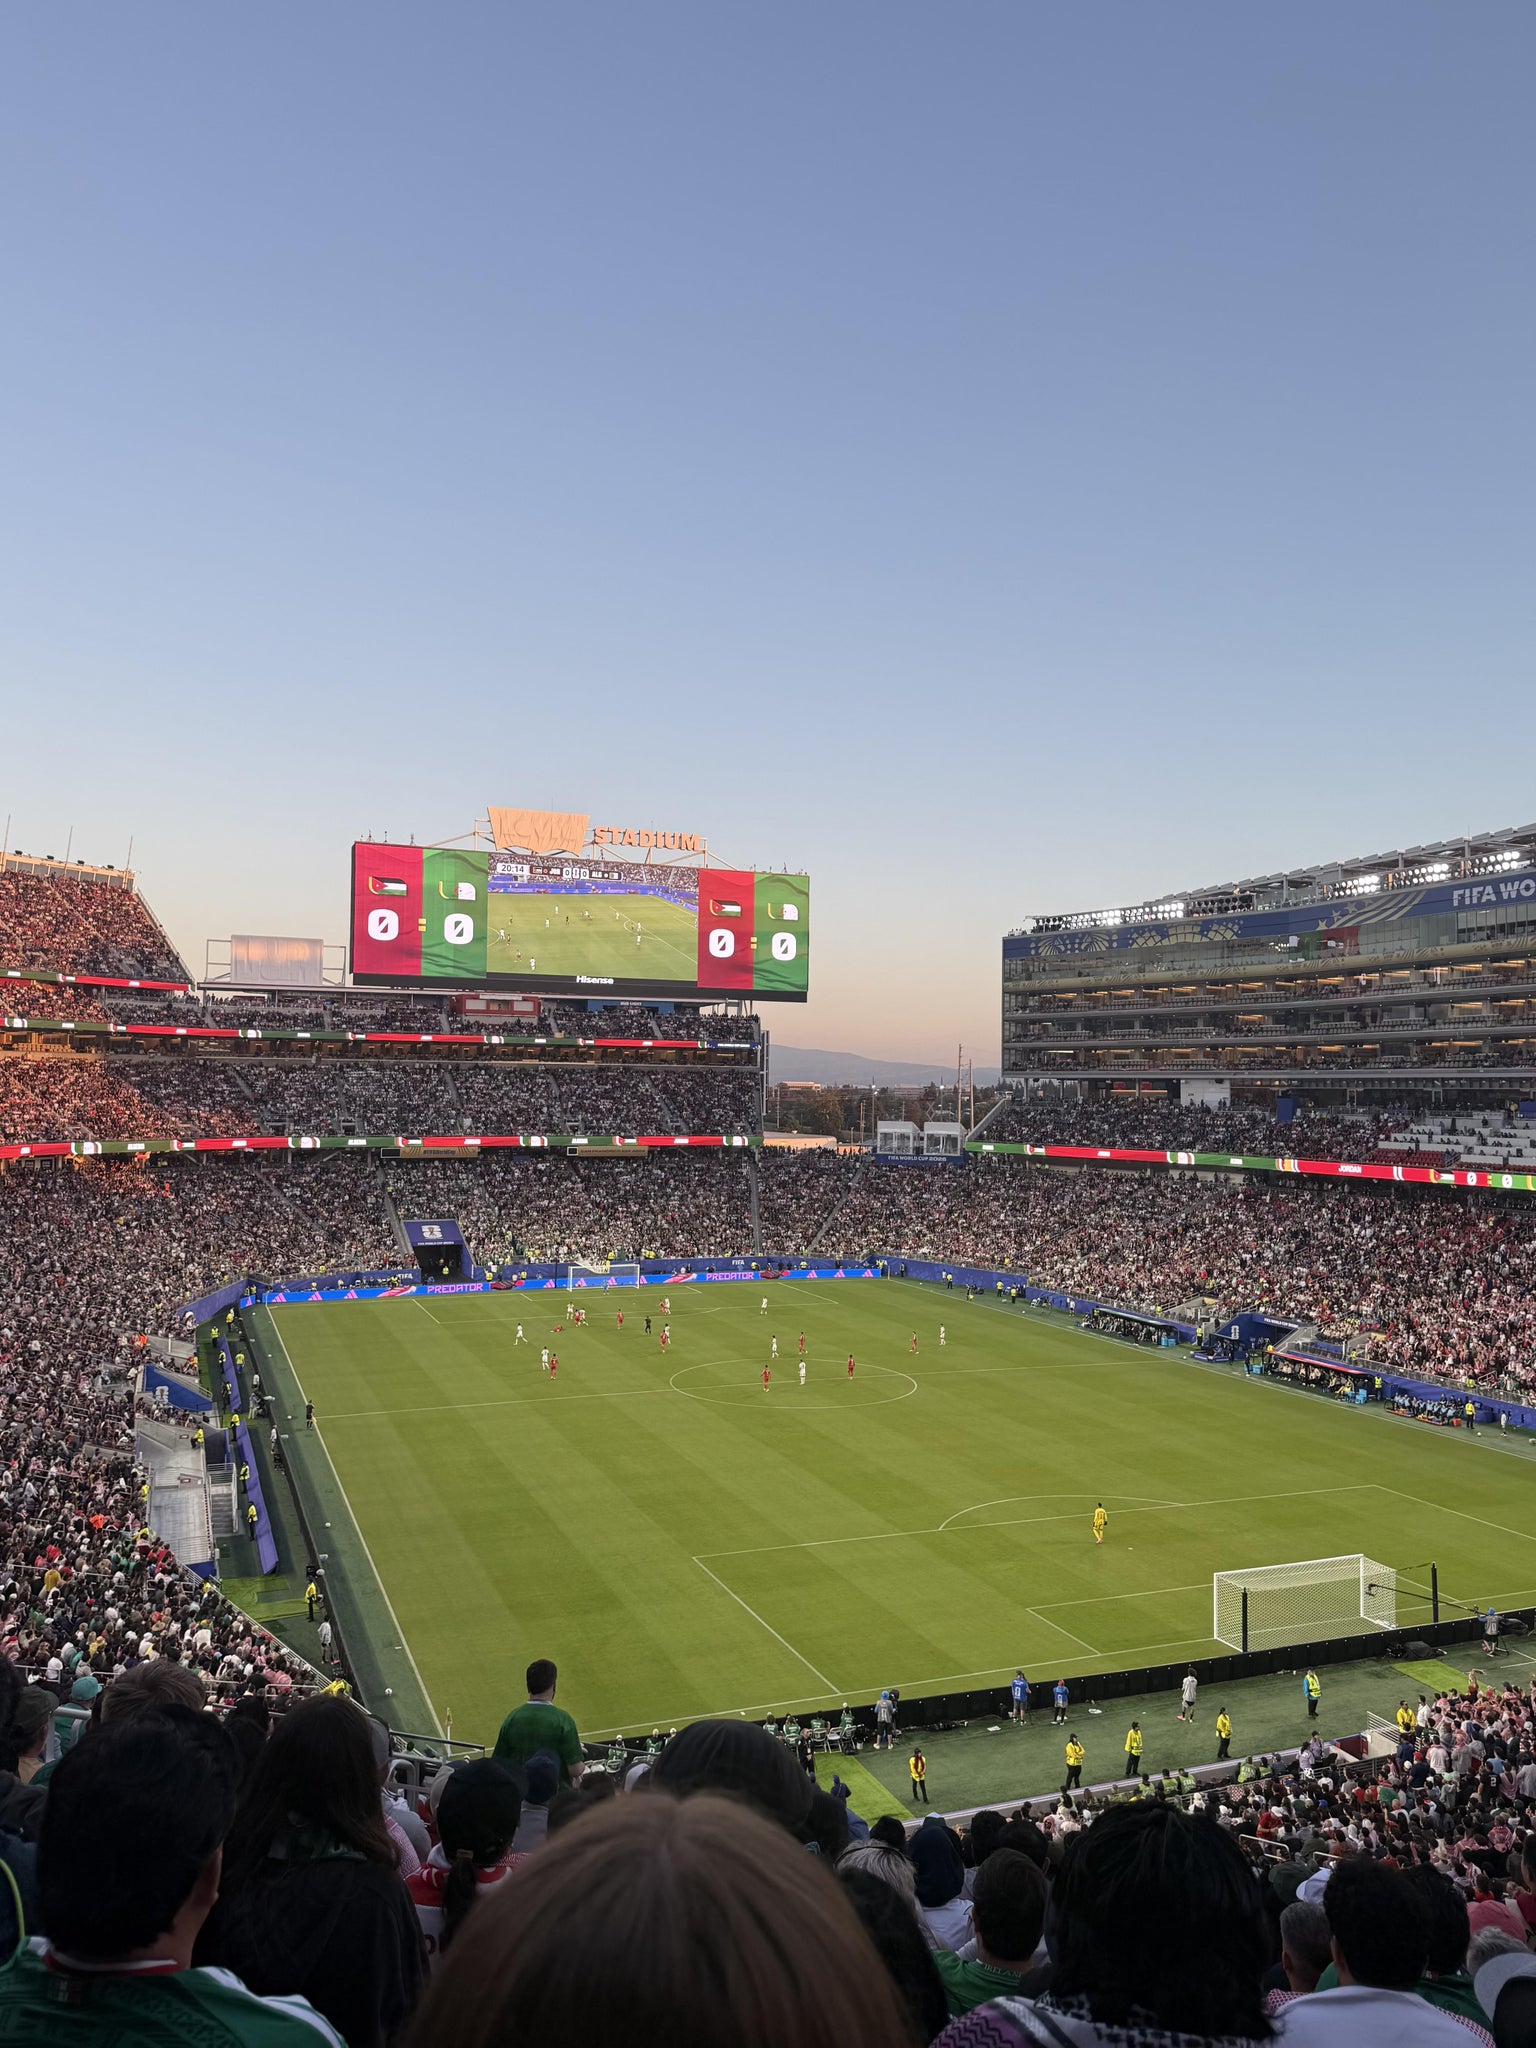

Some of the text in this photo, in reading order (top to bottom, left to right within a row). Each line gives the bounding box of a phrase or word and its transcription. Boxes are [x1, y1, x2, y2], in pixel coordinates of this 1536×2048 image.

[594, 826, 700, 850] STADIUM
[501, 864, 524, 873] 20:14
[1453, 885, 1497, 907] FIFA
[368, 909, 399, 941] 0
[444, 913, 474, 945] 0
[709, 929, 735, 958] 0
[772, 932, 797, 961] 0
[576, 975, 614, 985] Hisense
[706, 1271, 754, 1280] PREDATOR
[427, 1283, 483, 1293] PREDATOR
